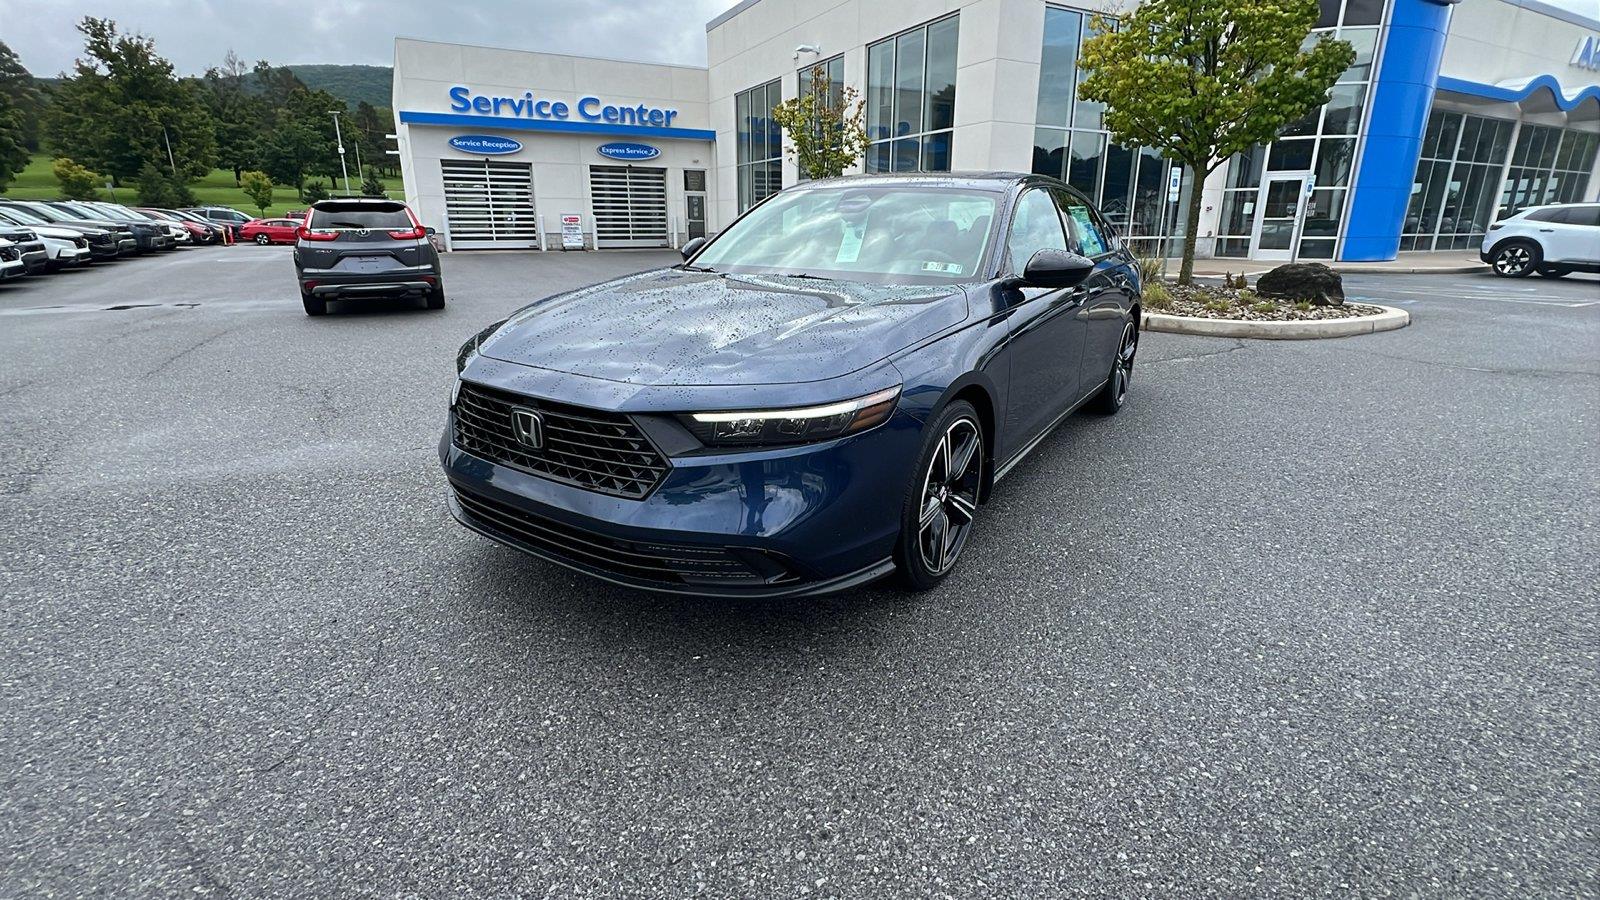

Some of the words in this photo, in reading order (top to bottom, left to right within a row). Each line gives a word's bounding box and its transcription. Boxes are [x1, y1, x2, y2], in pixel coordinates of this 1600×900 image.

[449, 86, 570, 119] Service
[577, 97, 678, 127] Center
[453, 139, 481, 147] Service
[482, 140, 518, 149] Reception
[601, 146, 625, 155] Express
[626, 147, 648, 155] Service
